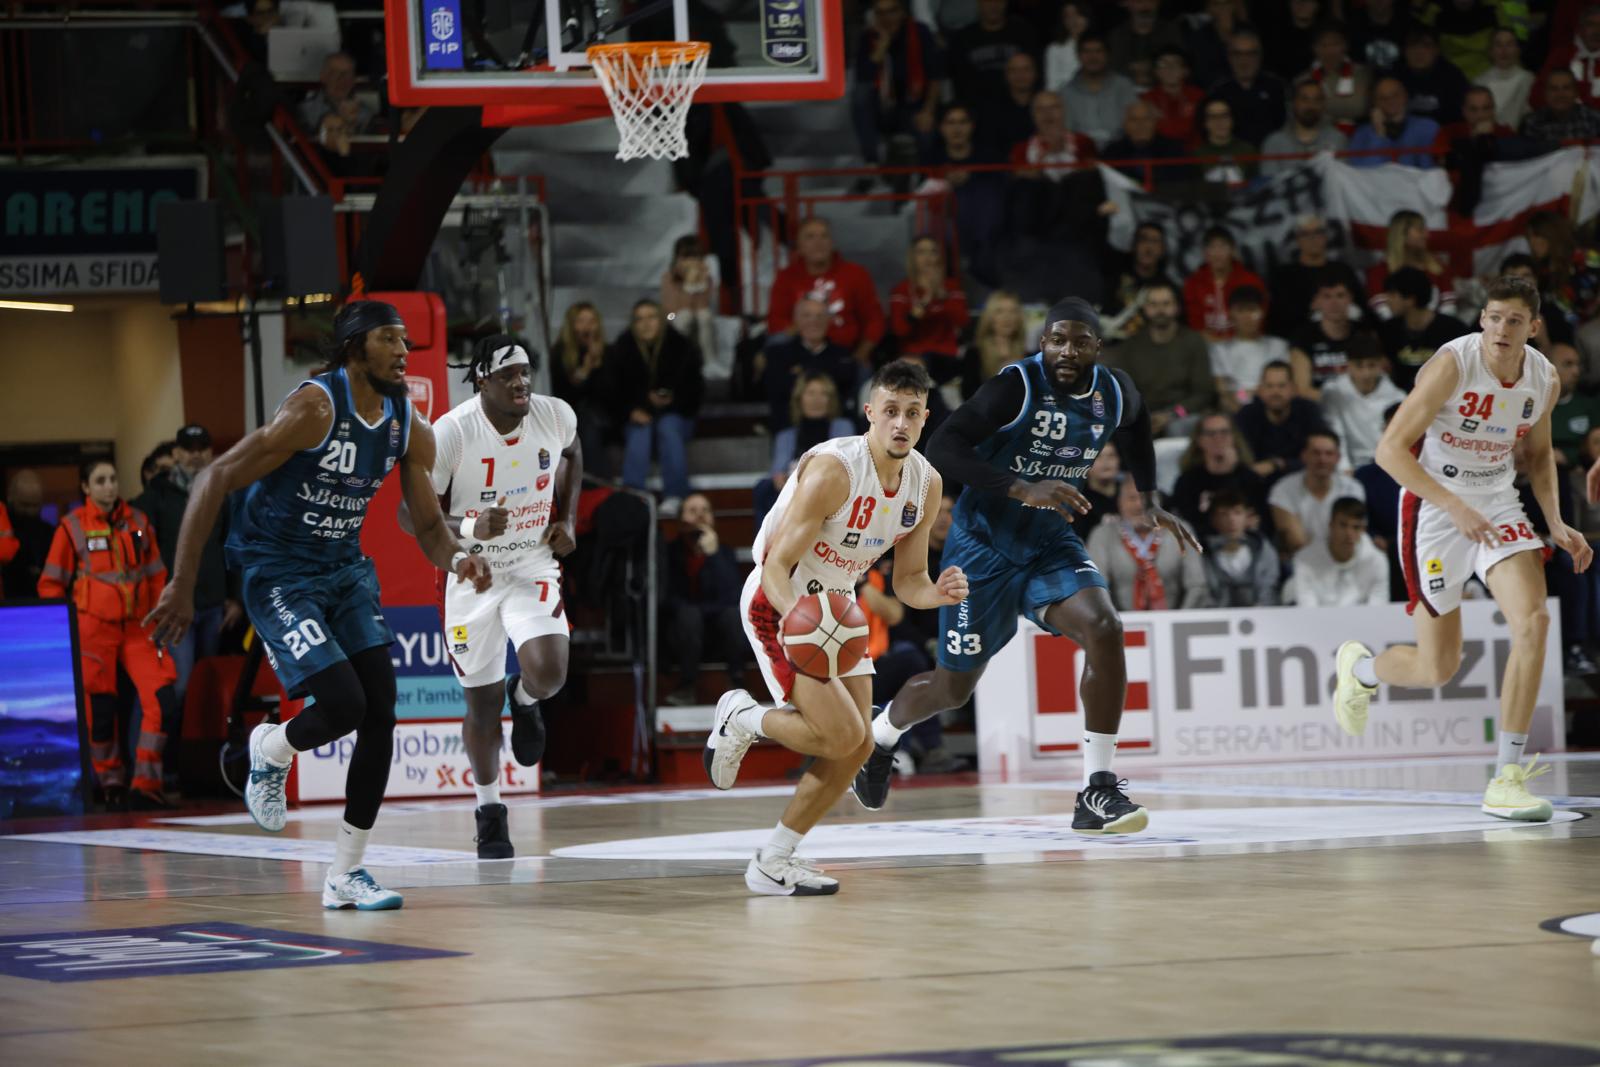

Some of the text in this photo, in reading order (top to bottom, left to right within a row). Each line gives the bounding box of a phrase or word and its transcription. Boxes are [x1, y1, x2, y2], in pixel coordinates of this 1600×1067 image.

[768, 13, 804, 28] LBA
[429, 42, 459, 55] FIP
[0, 262, 79, 289] SSIMA
[1458, 391, 1495, 421] 34
[1031, 410, 1067, 440] 33
[318, 440, 357, 474] 20
[481, 458, 495, 487] 7
[847, 495, 876, 530] 13
[1499, 522, 1535, 542] 34
[535, 581, 549, 602] 7
[283, 618, 328, 661] 20
[946, 629, 982, 656] 33
[1172, 610, 1510, 711] Finzi
[417, 687, 462, 704] l'amb
[1373, 718, 1398, 748] IN
[1411, 716, 1472, 746] PVC
[406, 764, 428, 782] by
